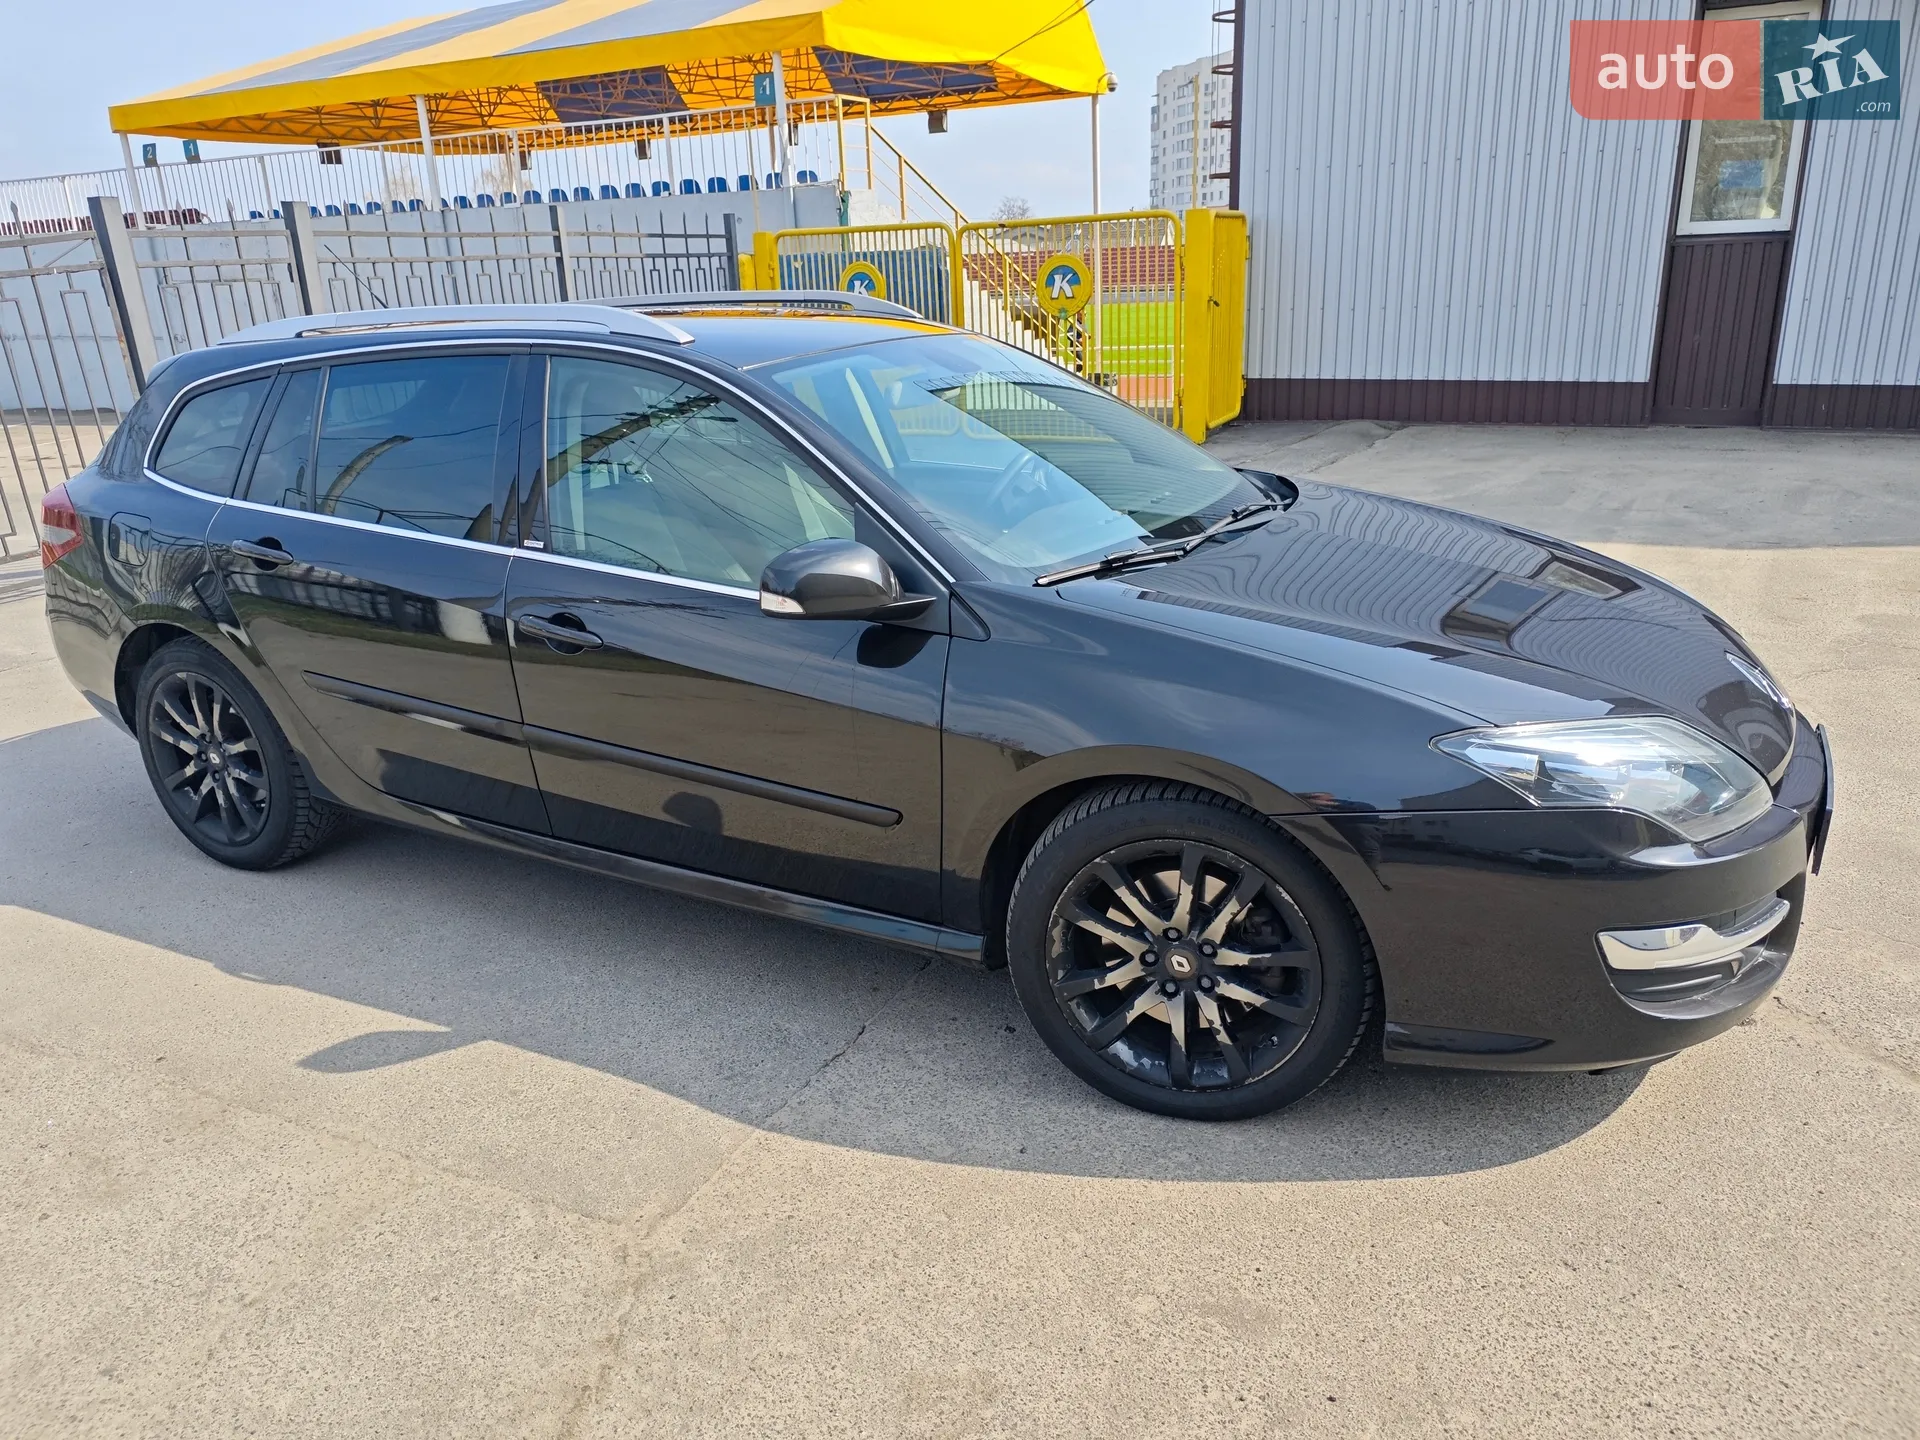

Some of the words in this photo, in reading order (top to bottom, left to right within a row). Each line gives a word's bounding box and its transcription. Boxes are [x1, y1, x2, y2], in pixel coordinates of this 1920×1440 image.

[147, 146, 152, 158] 2
[189, 143, 194, 156] 1
[1051, 273, 1075, 299] K
